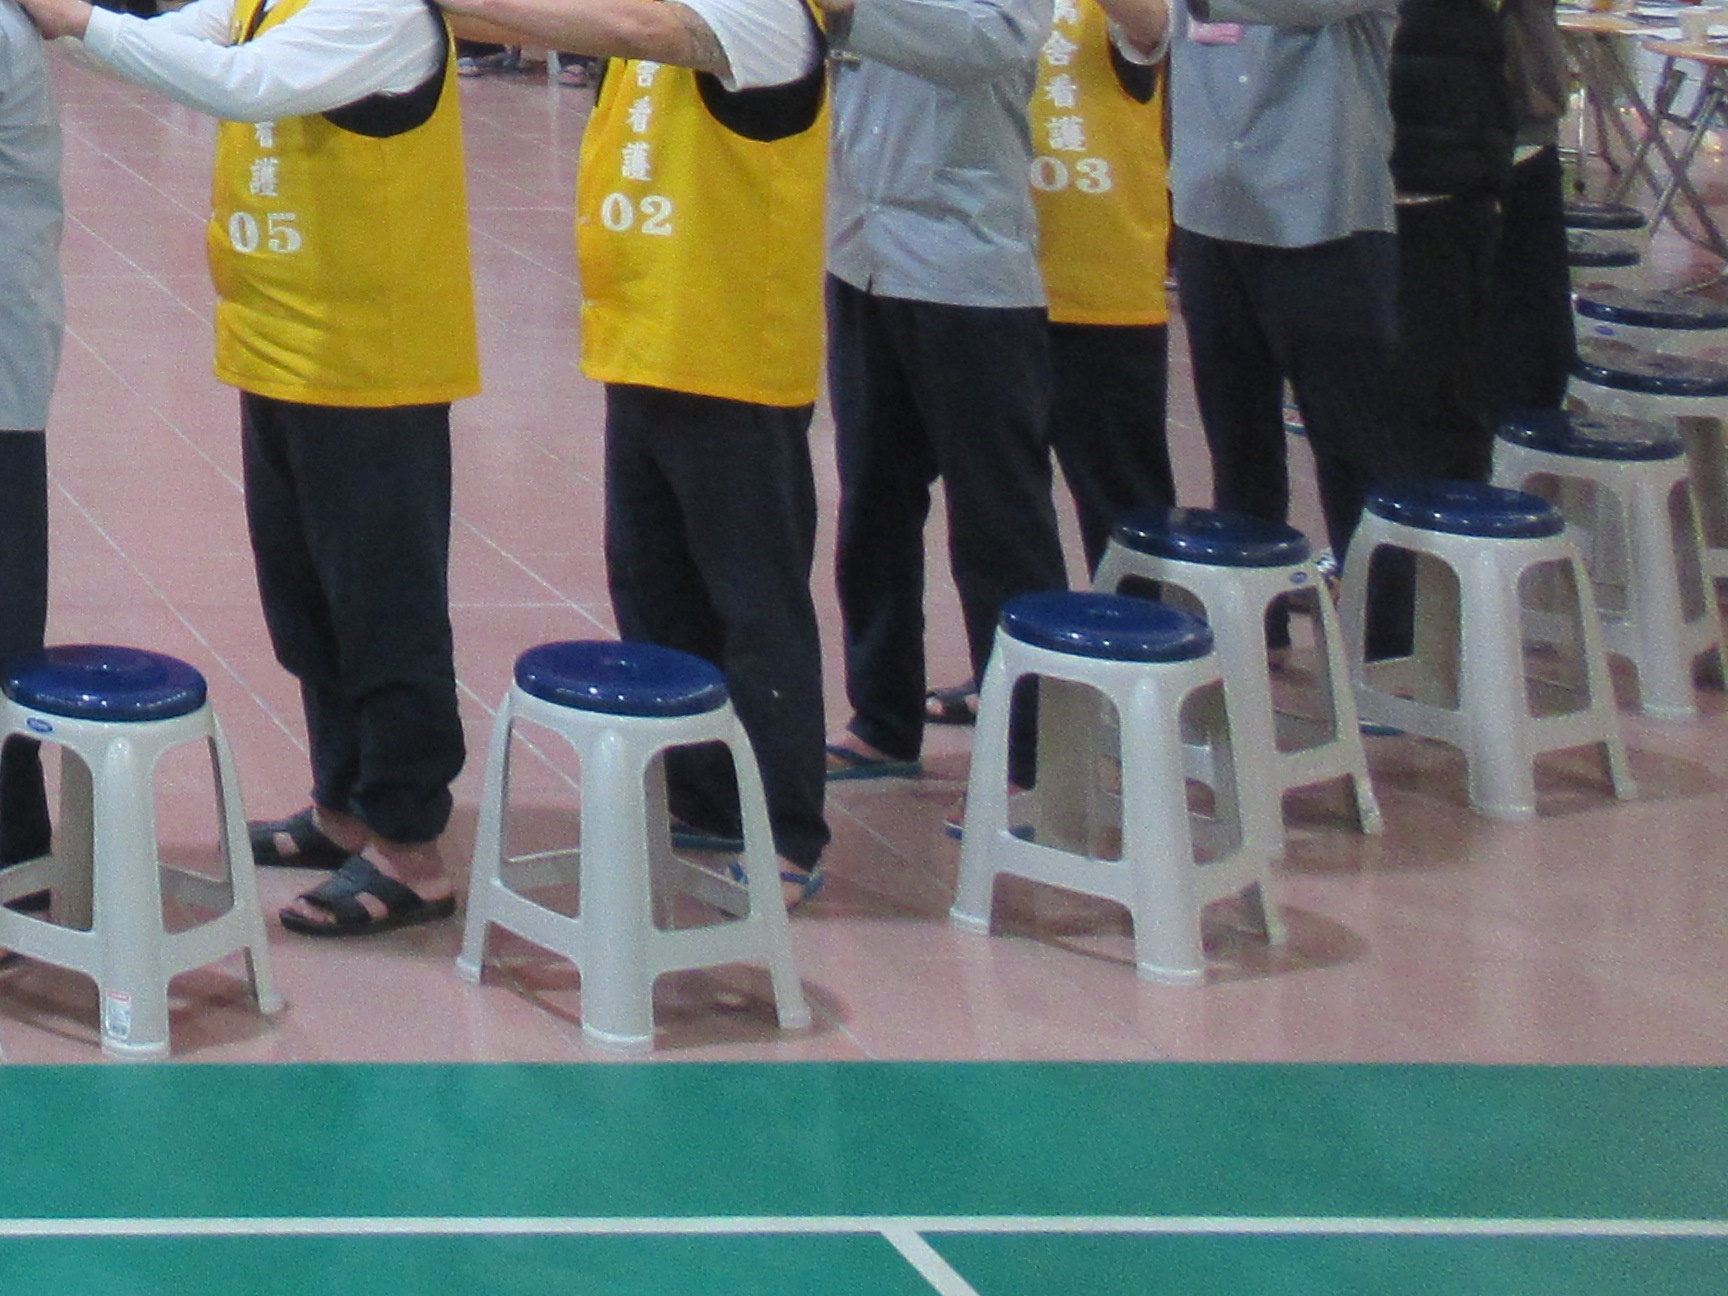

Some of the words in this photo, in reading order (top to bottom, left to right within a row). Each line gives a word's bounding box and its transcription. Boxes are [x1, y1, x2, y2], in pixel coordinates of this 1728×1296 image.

[1029, 156, 1113, 204] 03
[228, 211, 302, 253] 05
[601, 192, 673, 236] 02
